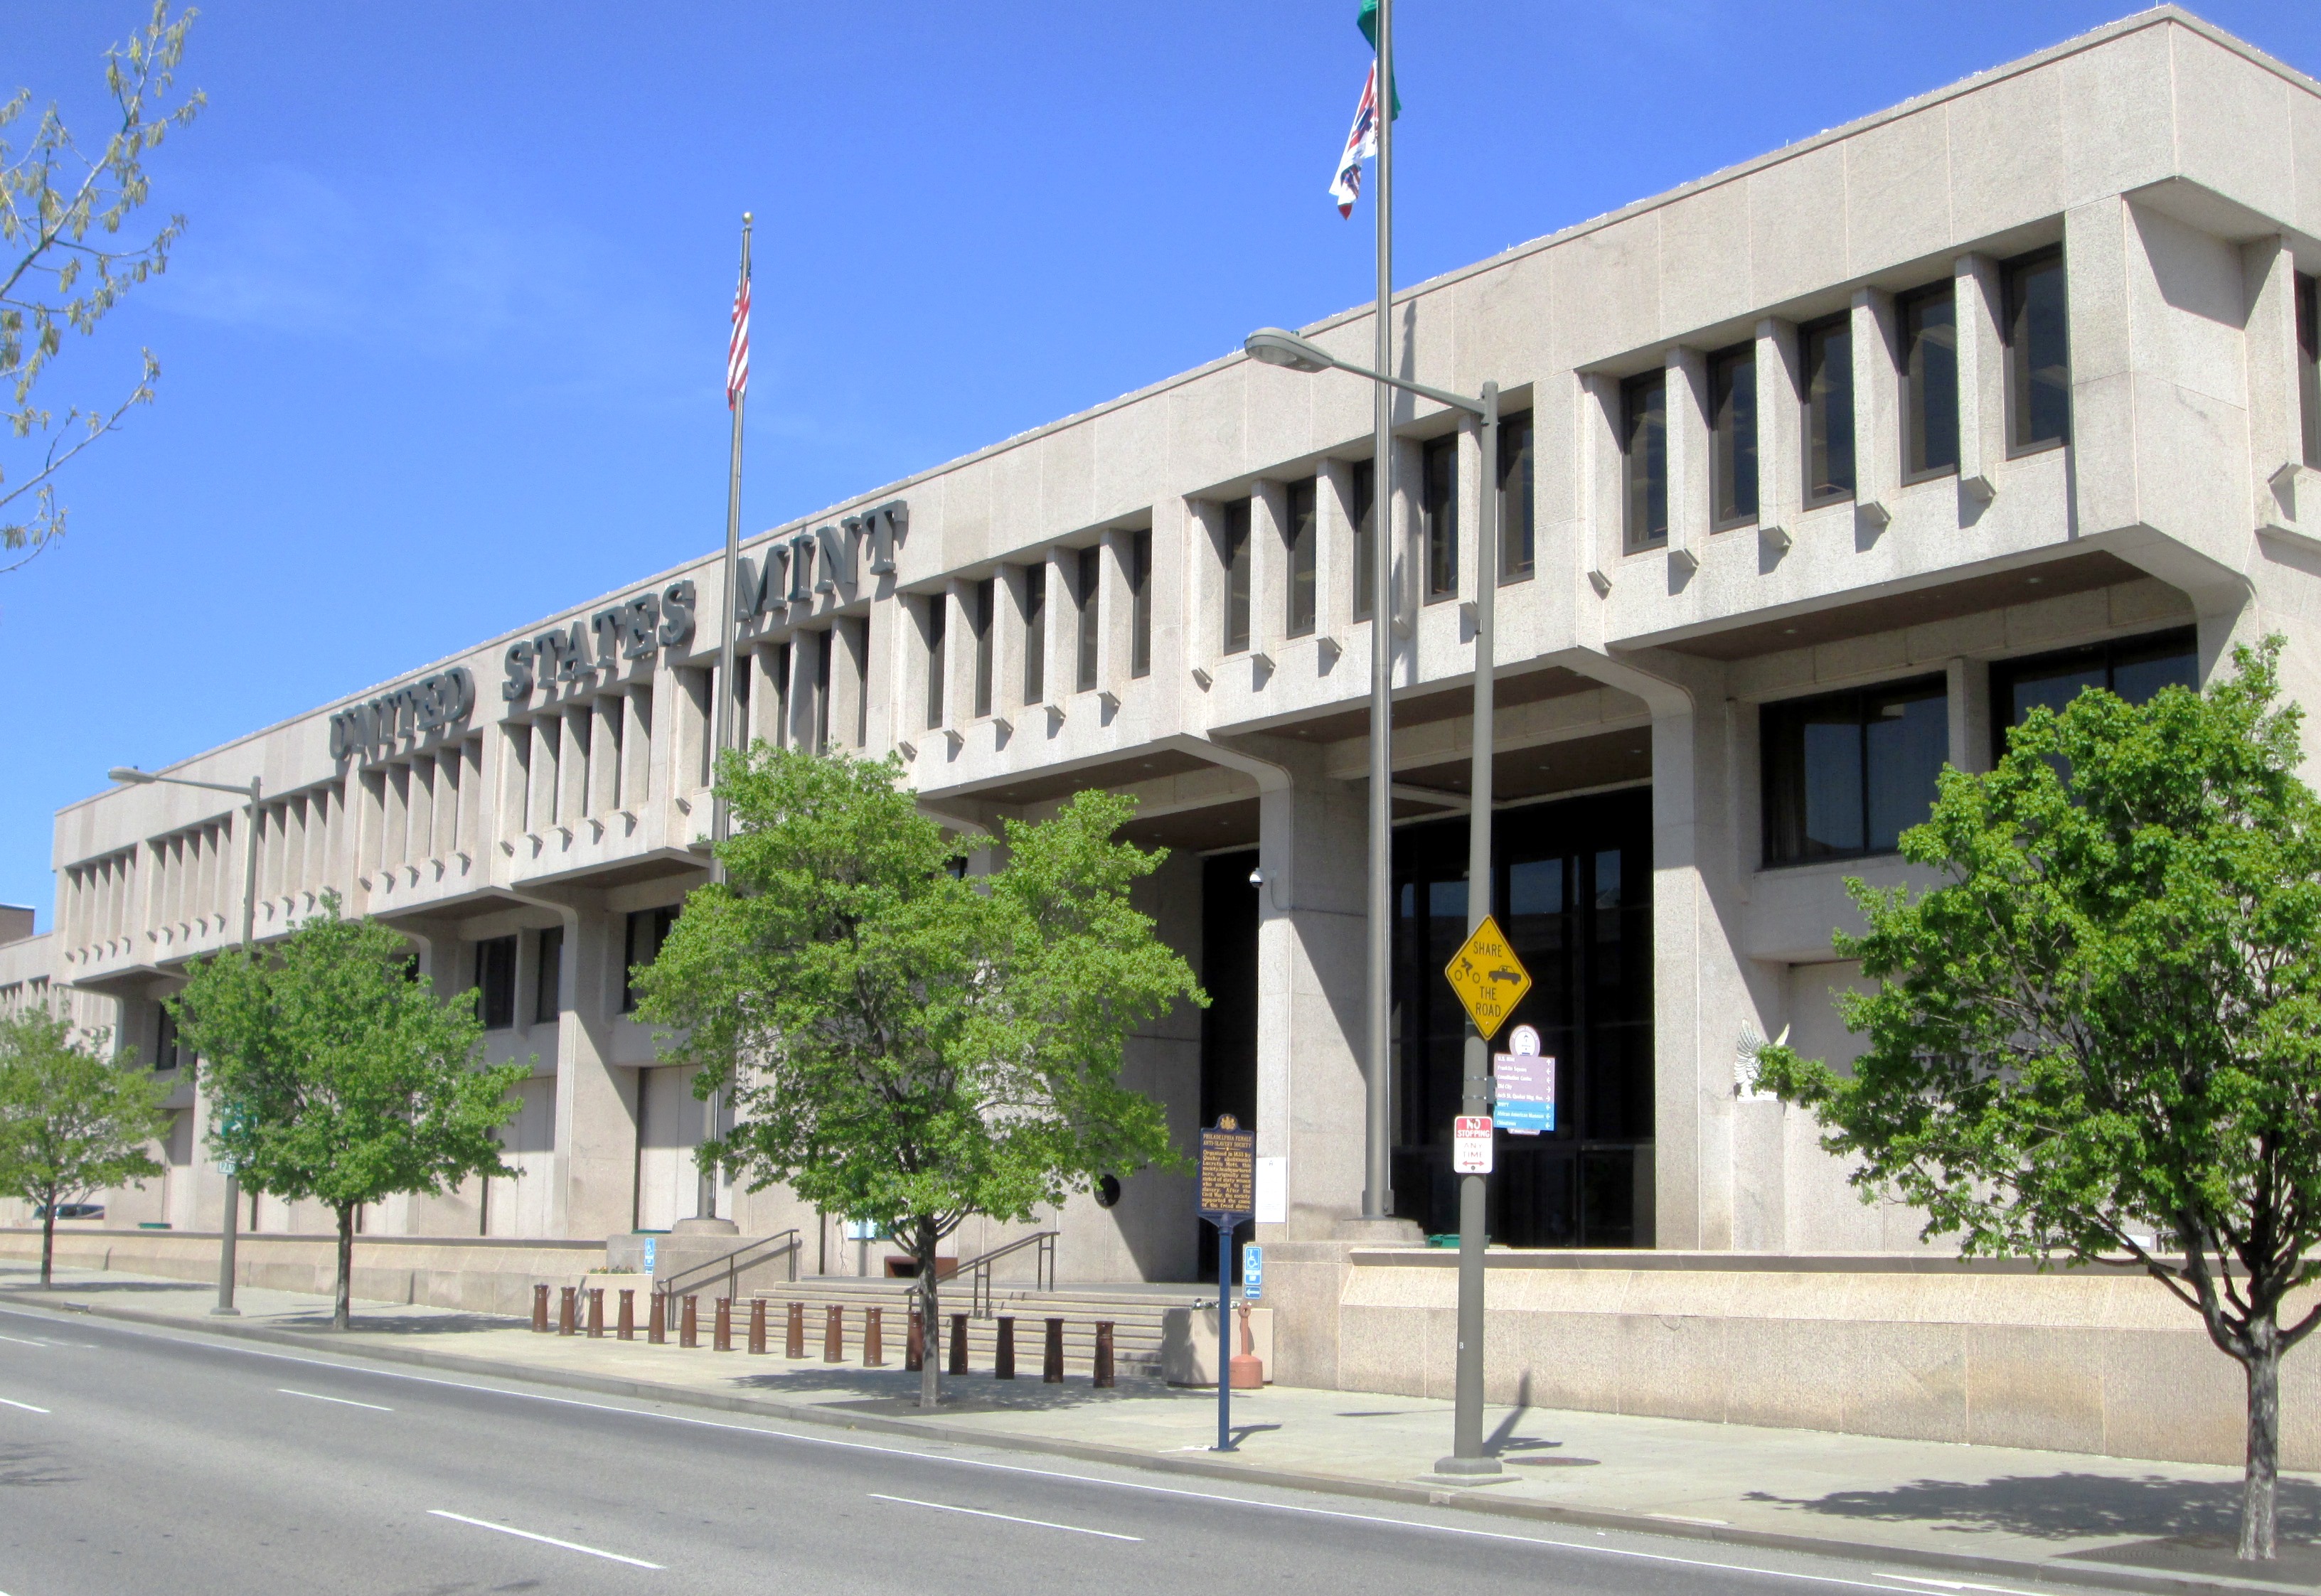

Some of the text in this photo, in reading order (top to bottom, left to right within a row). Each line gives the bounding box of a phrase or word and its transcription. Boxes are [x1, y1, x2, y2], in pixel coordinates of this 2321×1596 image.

[330, 499, 908, 761] UNITED STATES MINT
[1473, 942, 1503, 958] SHARE
[1480, 987, 1497, 1000] THE
[1476, 1002, 1500, 1017] ROAD
[1467, 1118, 1480, 1130] NO
